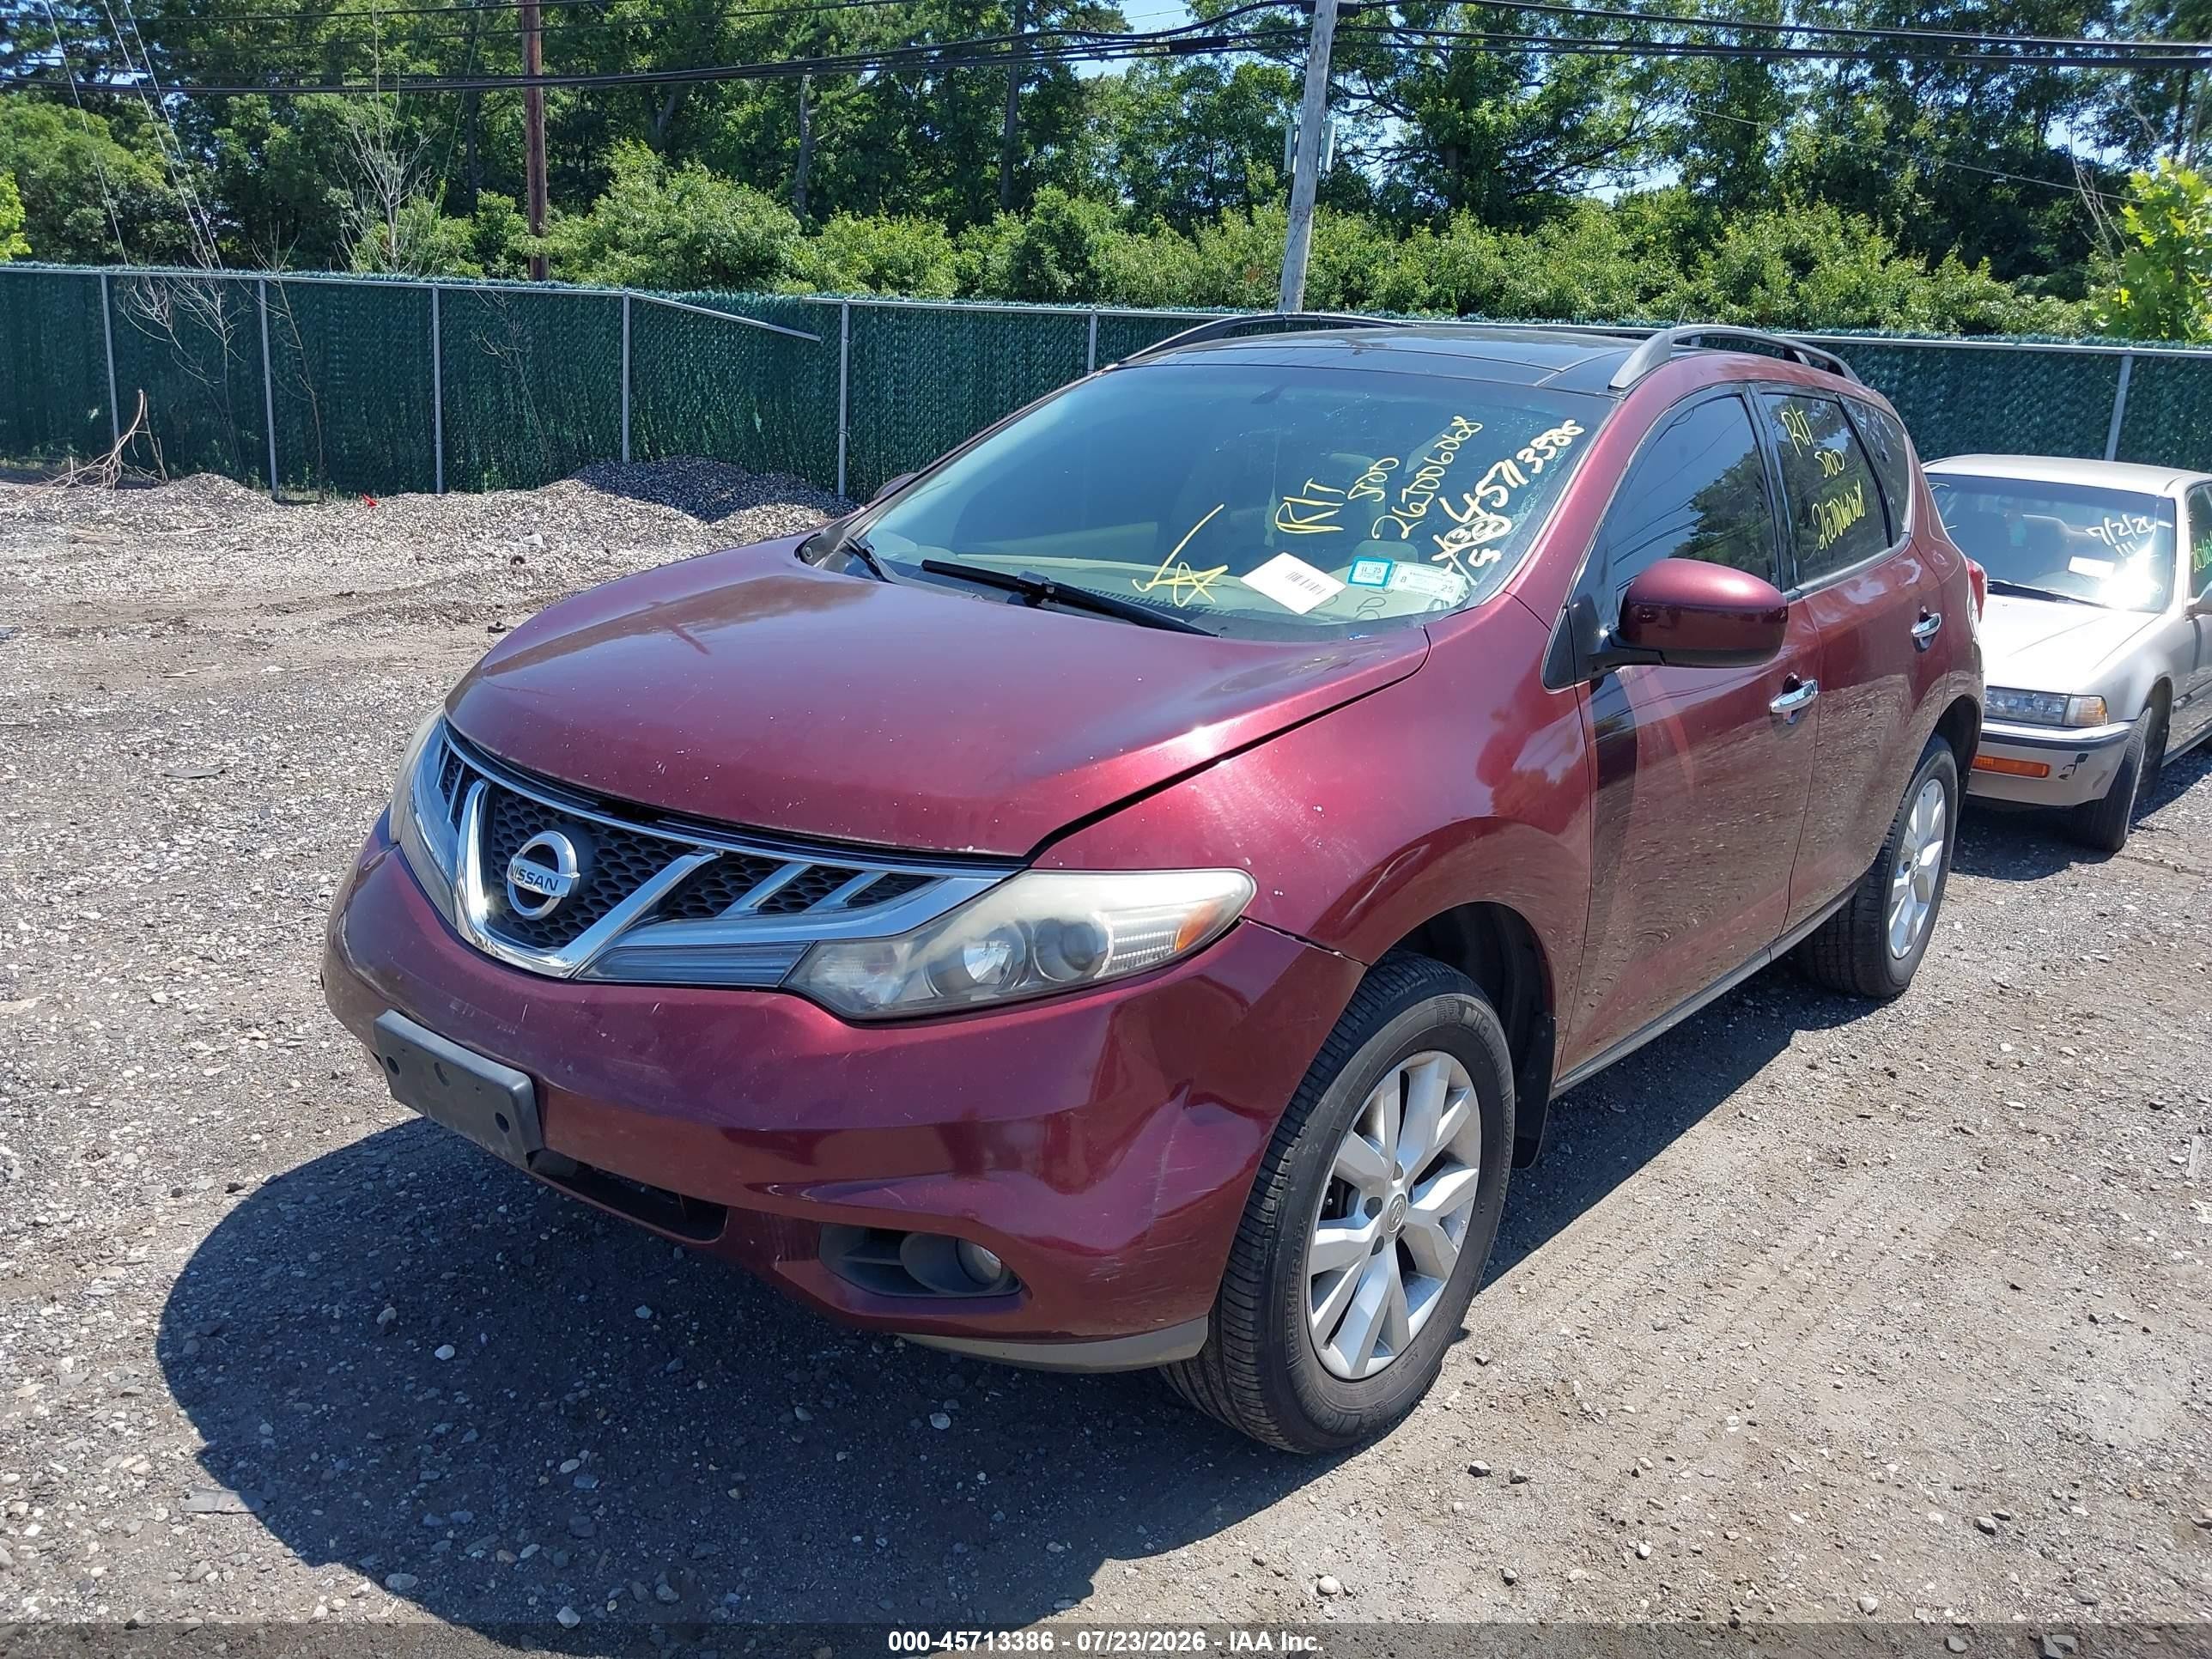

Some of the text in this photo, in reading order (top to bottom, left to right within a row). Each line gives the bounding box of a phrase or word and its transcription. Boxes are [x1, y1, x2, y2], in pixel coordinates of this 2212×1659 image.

[1440, 585, 1455, 593] 25
[509, 864, 559, 891] NISSAN
[1287, 1257, 1302, 1355] PREMIER
